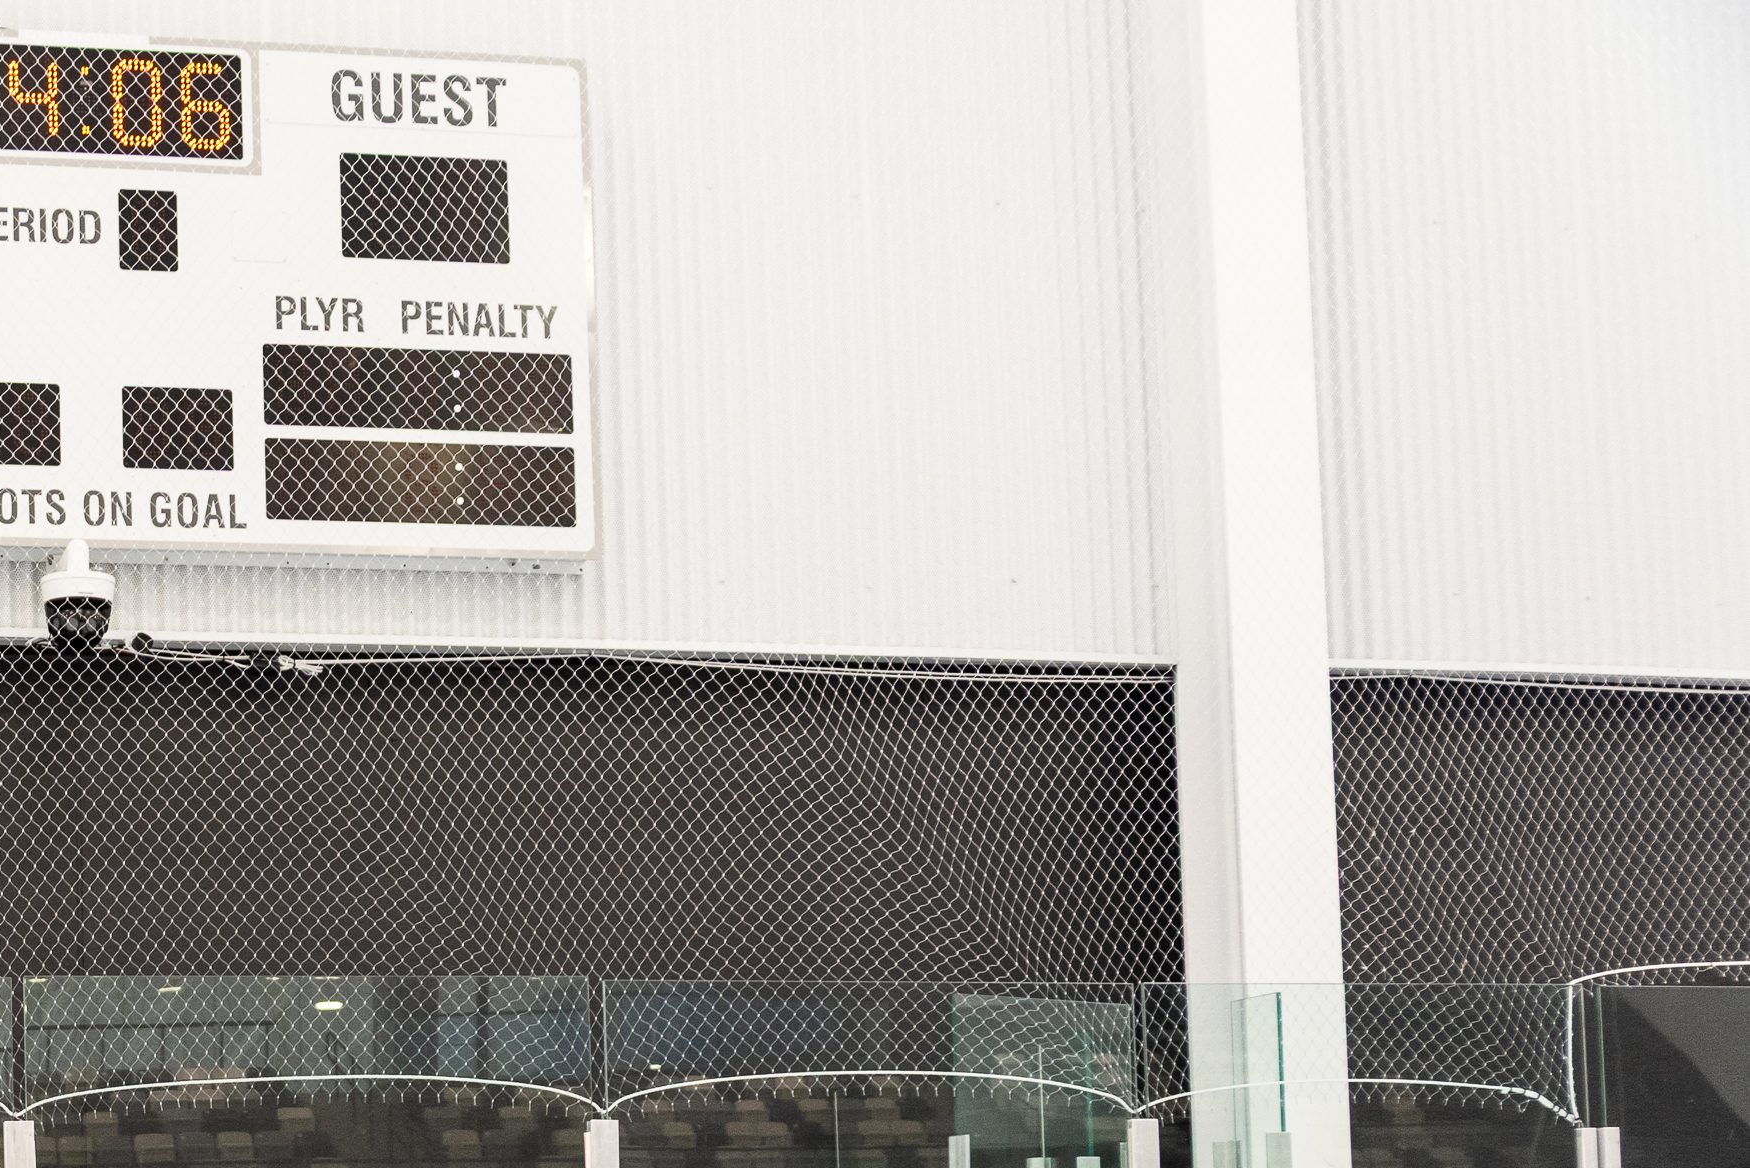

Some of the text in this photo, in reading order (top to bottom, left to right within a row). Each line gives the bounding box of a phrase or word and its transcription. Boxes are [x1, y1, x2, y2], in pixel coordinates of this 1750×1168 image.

[8, 59, 231, 151] 4:06
[331, 69, 507, 128] GUEST
[274, 295, 559, 340] PLYR PENALTY
[83, 490, 135, 528] ON
[148, 491, 248, 531] GOAL
